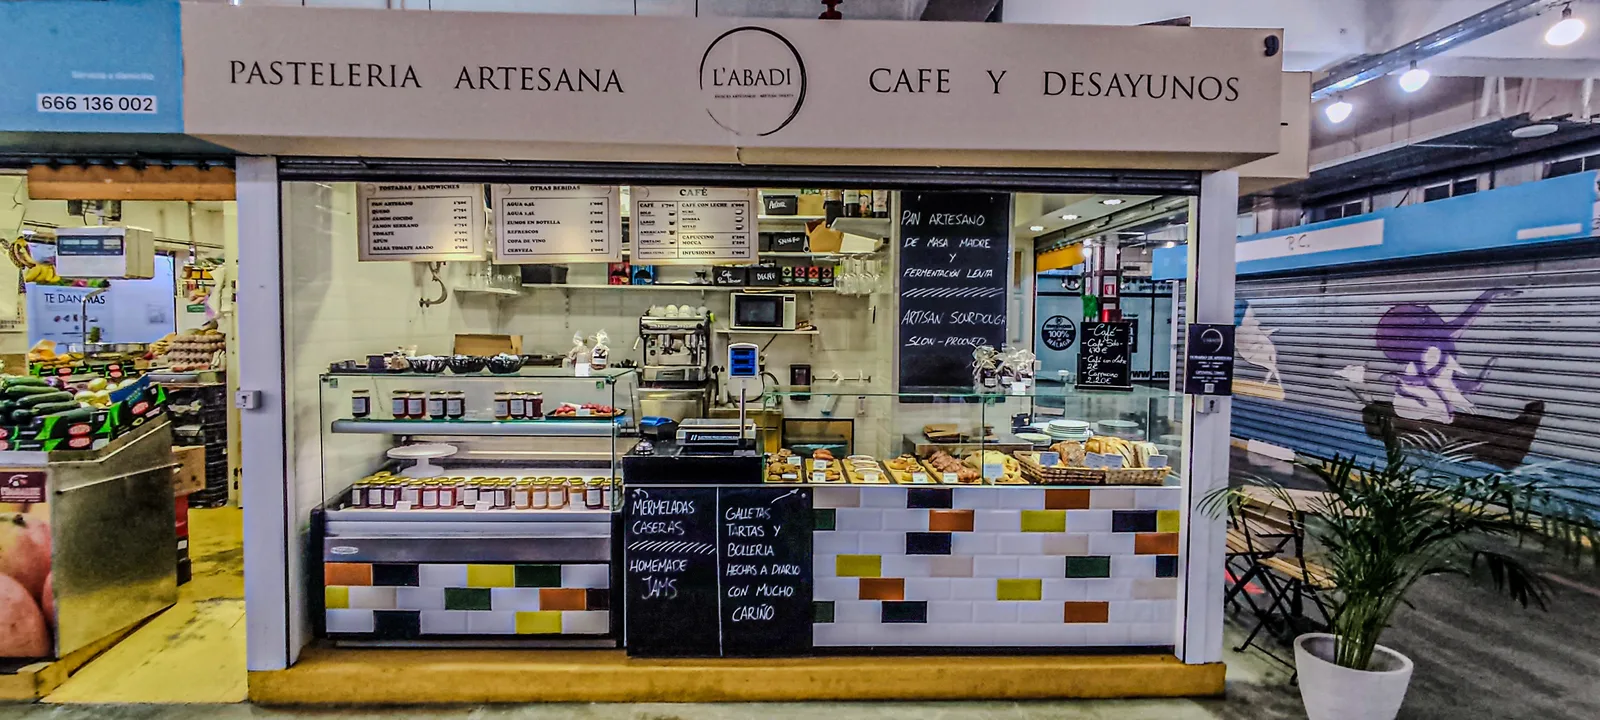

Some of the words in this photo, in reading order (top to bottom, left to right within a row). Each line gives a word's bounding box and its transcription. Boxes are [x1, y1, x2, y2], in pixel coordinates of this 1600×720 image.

[1264, 35, 1279, 56] 9
[230, 60, 422, 88] PASTELERIA
[454, 66, 624, 93] ARTESANA
[713, 67, 791, 86] L'ABADI
[869, 68, 950, 93] CAFE
[986, 70, 1007, 94] Y
[1043, 71, 1240, 102] DESAYUNOS
[42, 96, 76, 110] 666
[82, 96, 113, 110] 136
[118, 97, 153, 111] 002
[680, 187, 708, 196] CAFÉ
[901, 210, 920, 226] PAN
[929, 214, 985, 226] ARTESANO
[904, 238, 919, 248] DE
[927, 236, 948, 248] MASA
[959, 238, 991, 248] MADRE
[949, 253, 957, 262] Y
[966, 269, 993, 278] LENTA
[44, 293, 54, 303] TE
[58, 294, 82, 303] DAN
[901, 309, 944, 325] ARTISAN
[632, 500, 695, 516] MERMELADAS
[725, 507, 772, 521] GALLETAS
[632, 520, 685, 536] CASERAS
[726, 523, 765, 537] TARTAS
[773, 525, 781, 536] Y
[630, 559, 688, 573] HOMEMADE
[726, 563, 758, 576] HECHAS
[760, 565, 767, 574] A
[771, 564, 800, 576] DIARIO
[641, 576, 678, 600] JAMS
[728, 585, 749, 597] CON
[756, 584, 793, 597] MUCHO
[732, 603, 774, 622] CARIÑO
